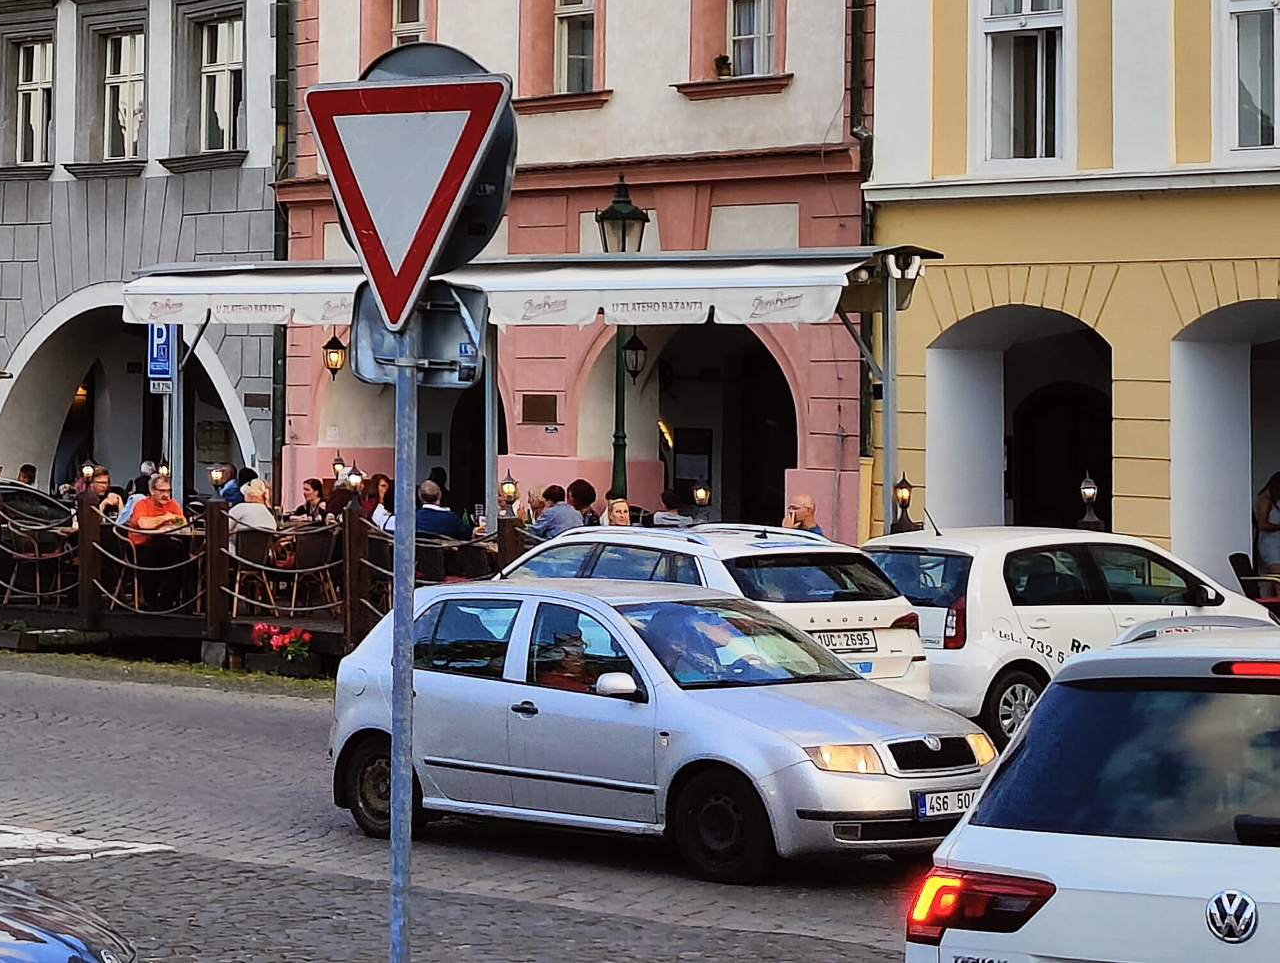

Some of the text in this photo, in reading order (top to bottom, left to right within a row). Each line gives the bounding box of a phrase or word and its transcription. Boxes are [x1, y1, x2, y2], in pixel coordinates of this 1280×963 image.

[153, 323, 167, 358] P
[844, 633, 870, 647] 2695
[1026, 636, 1054, 659] 732
[929, 794, 949, 813] 4S6
